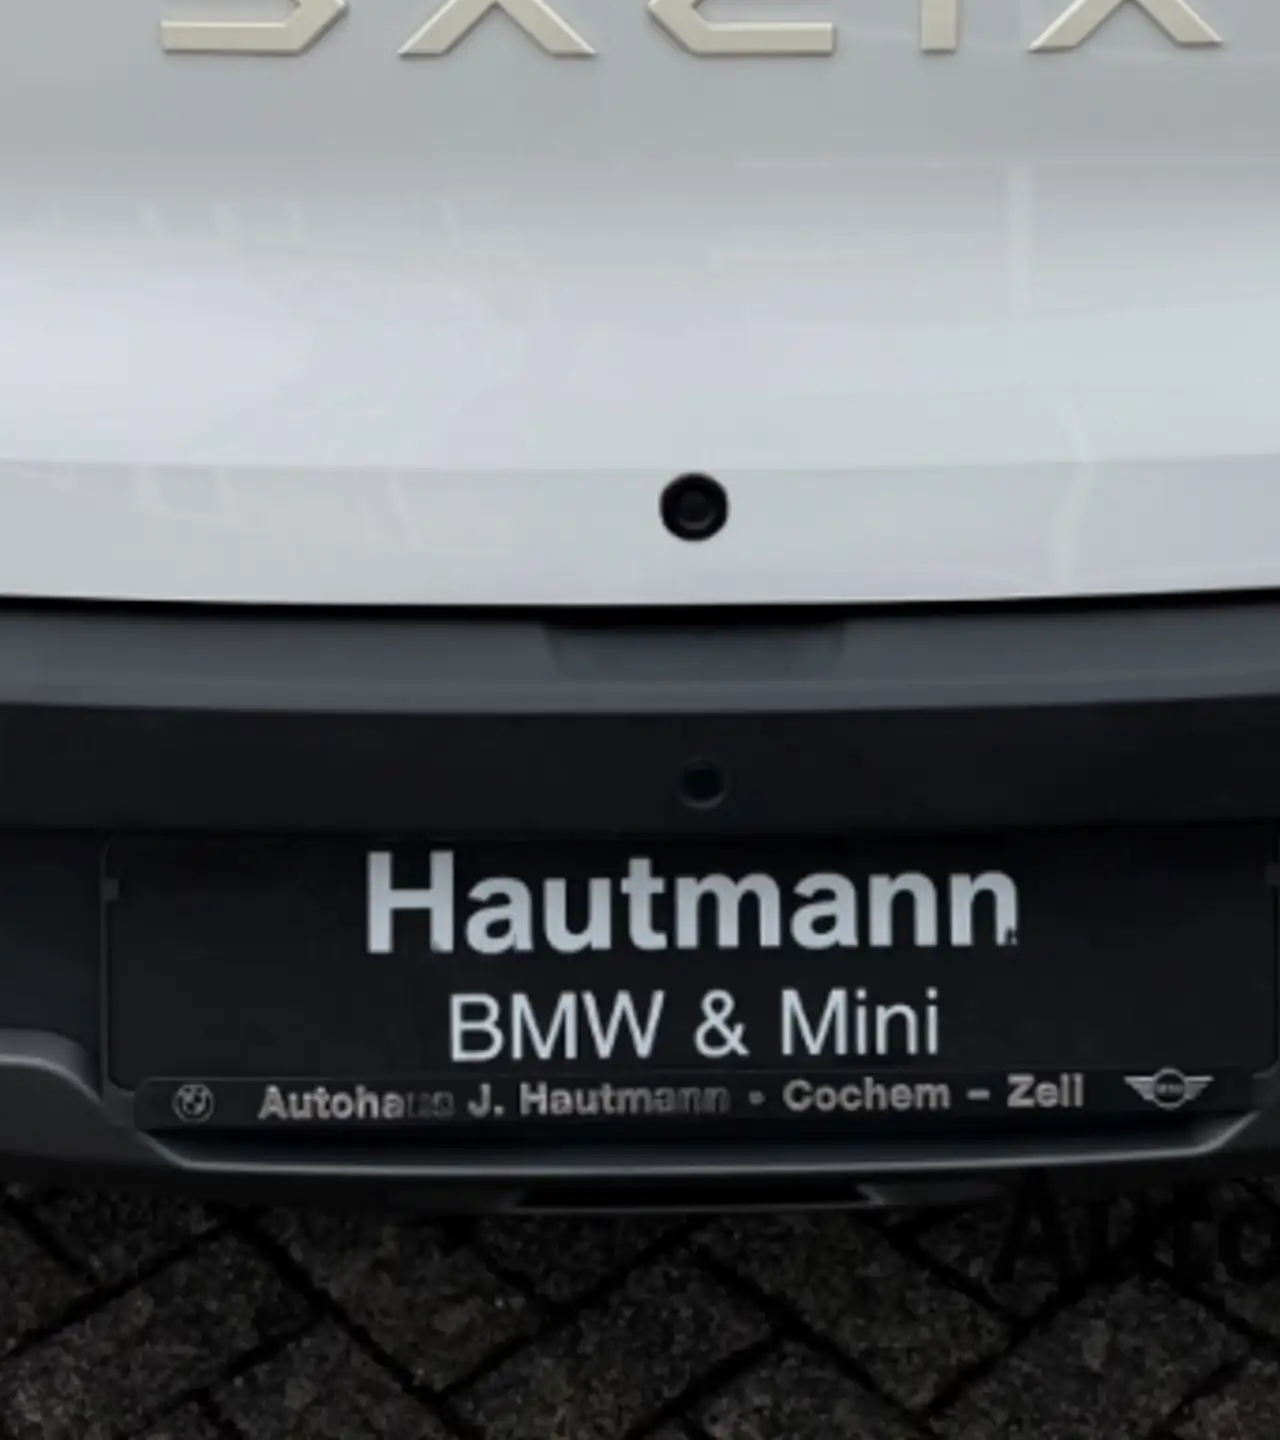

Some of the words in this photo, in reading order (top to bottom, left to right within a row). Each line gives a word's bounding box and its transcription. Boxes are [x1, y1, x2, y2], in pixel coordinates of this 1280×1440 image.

[366, 850, 1019, 954] Hautmann
[449, 990, 666, 1063] BMW
[693, 990, 750, 1059] &
[780, 987, 941, 1057] Mini
[257, 1083, 456, 1120] Autohaus
[467, 1083, 505, 1118] J.
[519, 1080, 730, 1117] Hautmann
[781, 1075, 953, 1112] Cochem
[1006, 1072, 1086, 1109] Zell
